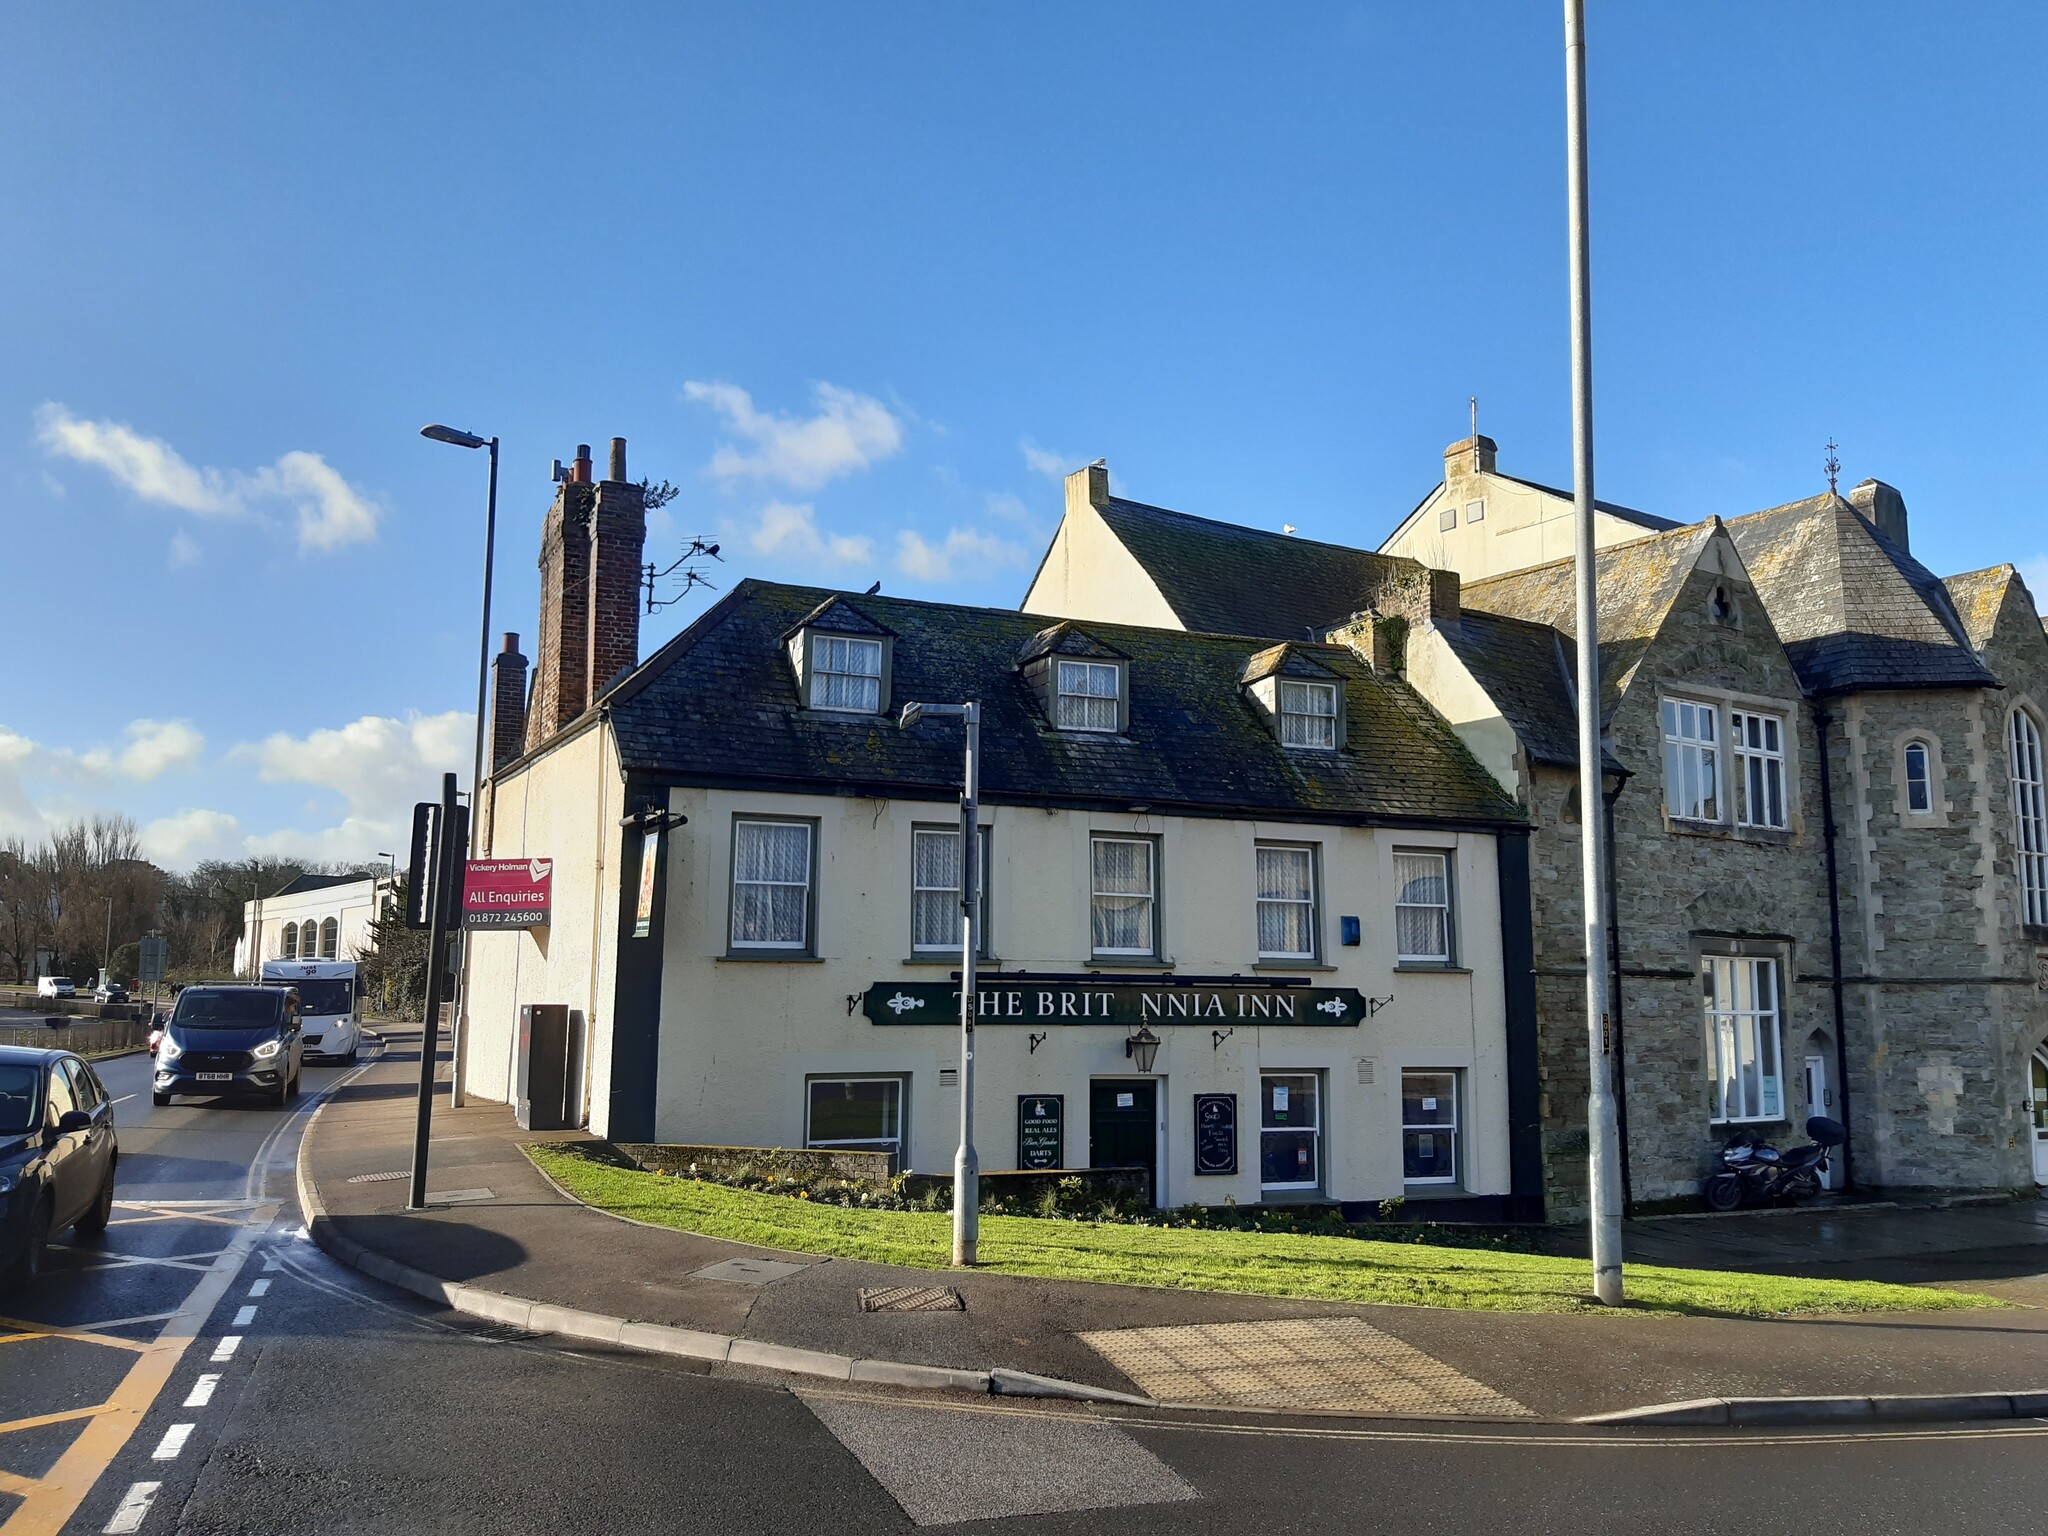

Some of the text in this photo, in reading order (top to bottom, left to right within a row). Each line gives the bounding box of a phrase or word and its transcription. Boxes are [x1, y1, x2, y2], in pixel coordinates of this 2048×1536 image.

[469, 863, 528, 873] Vickery Holman
[469, 890, 545, 905] All Enquiries
[469, 911, 543, 923] 01872 245600
[952, 991, 1023, 1016] THE
[1237, 993, 1296, 1018] INN
